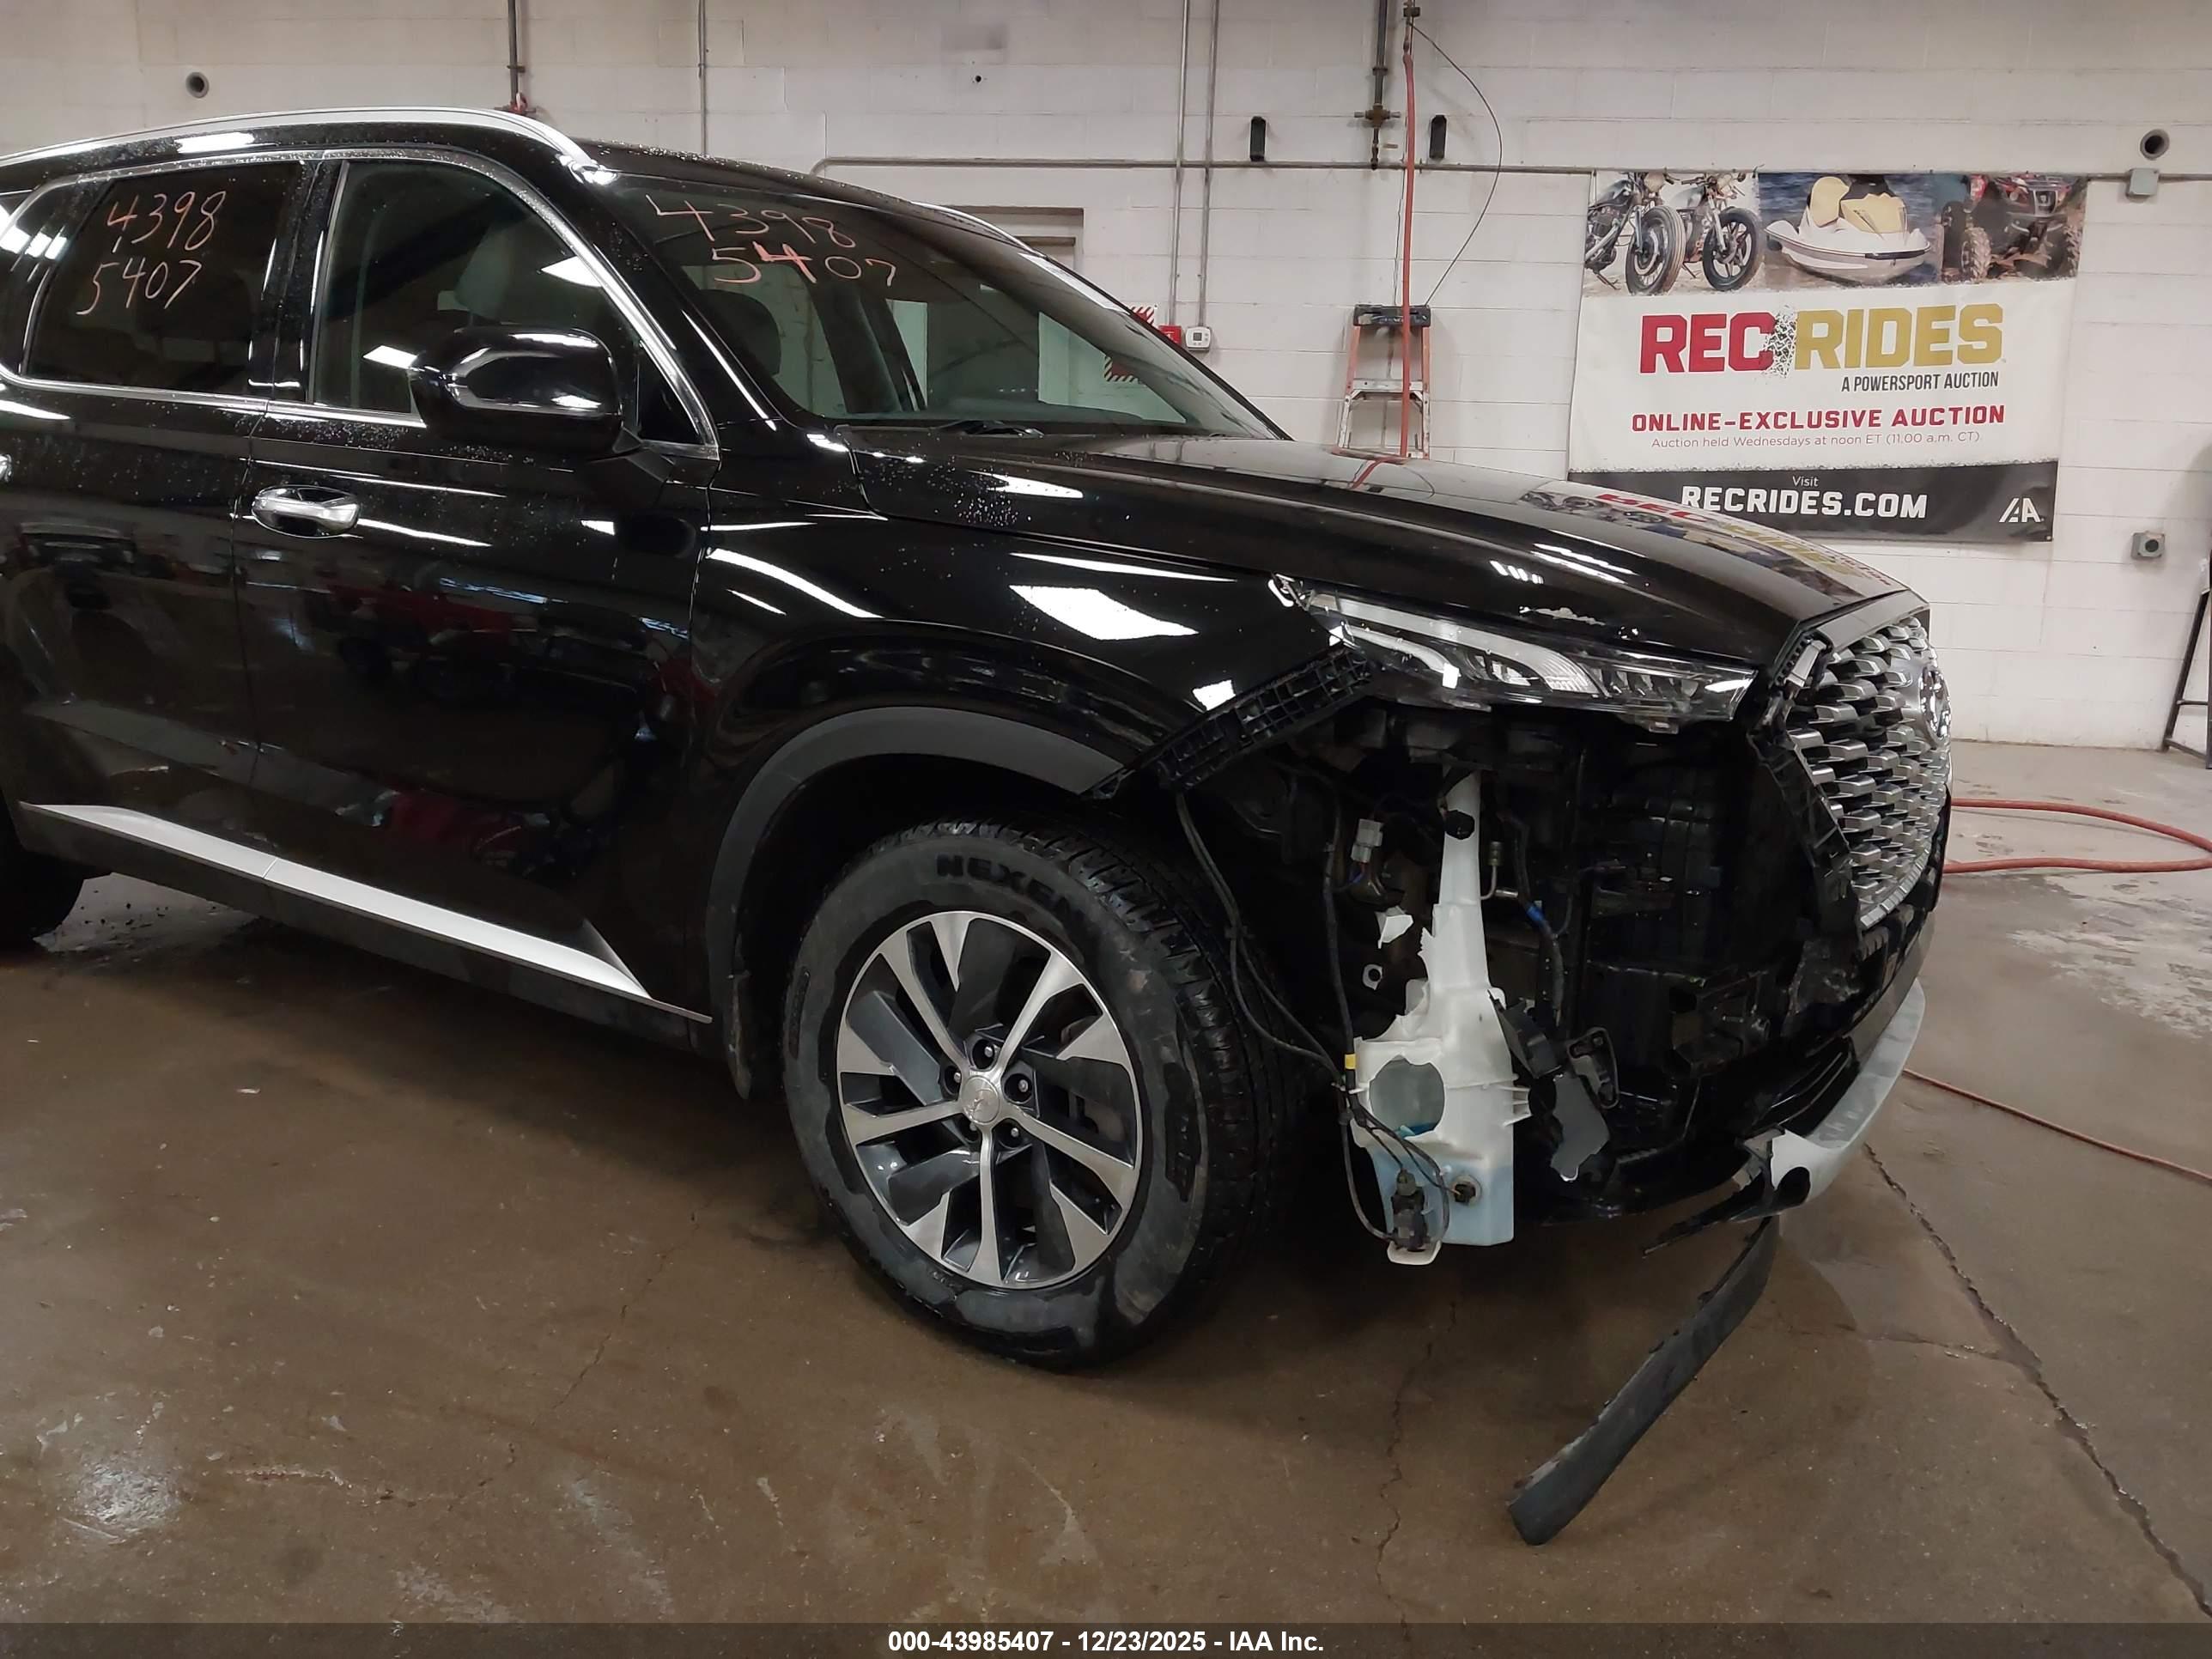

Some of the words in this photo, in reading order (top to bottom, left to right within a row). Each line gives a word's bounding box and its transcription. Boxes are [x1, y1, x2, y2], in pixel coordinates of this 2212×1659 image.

[106, 191, 227, 253] 4398
[645, 194, 857, 248] 4398
[76, 257, 203, 315] 5407
[711, 240, 897, 287] 5407
[1639, 311, 1777, 374] REC
[1794, 303, 2004, 370] RIDES
[1841, 375, 1850, 392] A
[1853, 374, 1941, 392] POWERSPORT
[1944, 370, 1999, 390] AUCTION
[1632, 409, 1883, 433] ONLINE-EXCLUSIVE
[1891, 404, 2005, 428] AUCTION
[1651, 435, 1698, 448] Auction
[1703, 435, 1729, 447] held
[1734, 434, 1811, 448] Wednesdays
[1814, 434, 1827, 446] at
[1831, 435, 1862, 446] noon
[1866, 434, 1882, 445] ET
[1926, 433, 1954, 443] a.m.
[1681, 485, 1928, 519] RECRIDES.COM
[1792, 476, 1820, 487] Visit
[936, 853, 1084, 927] NEXEN
